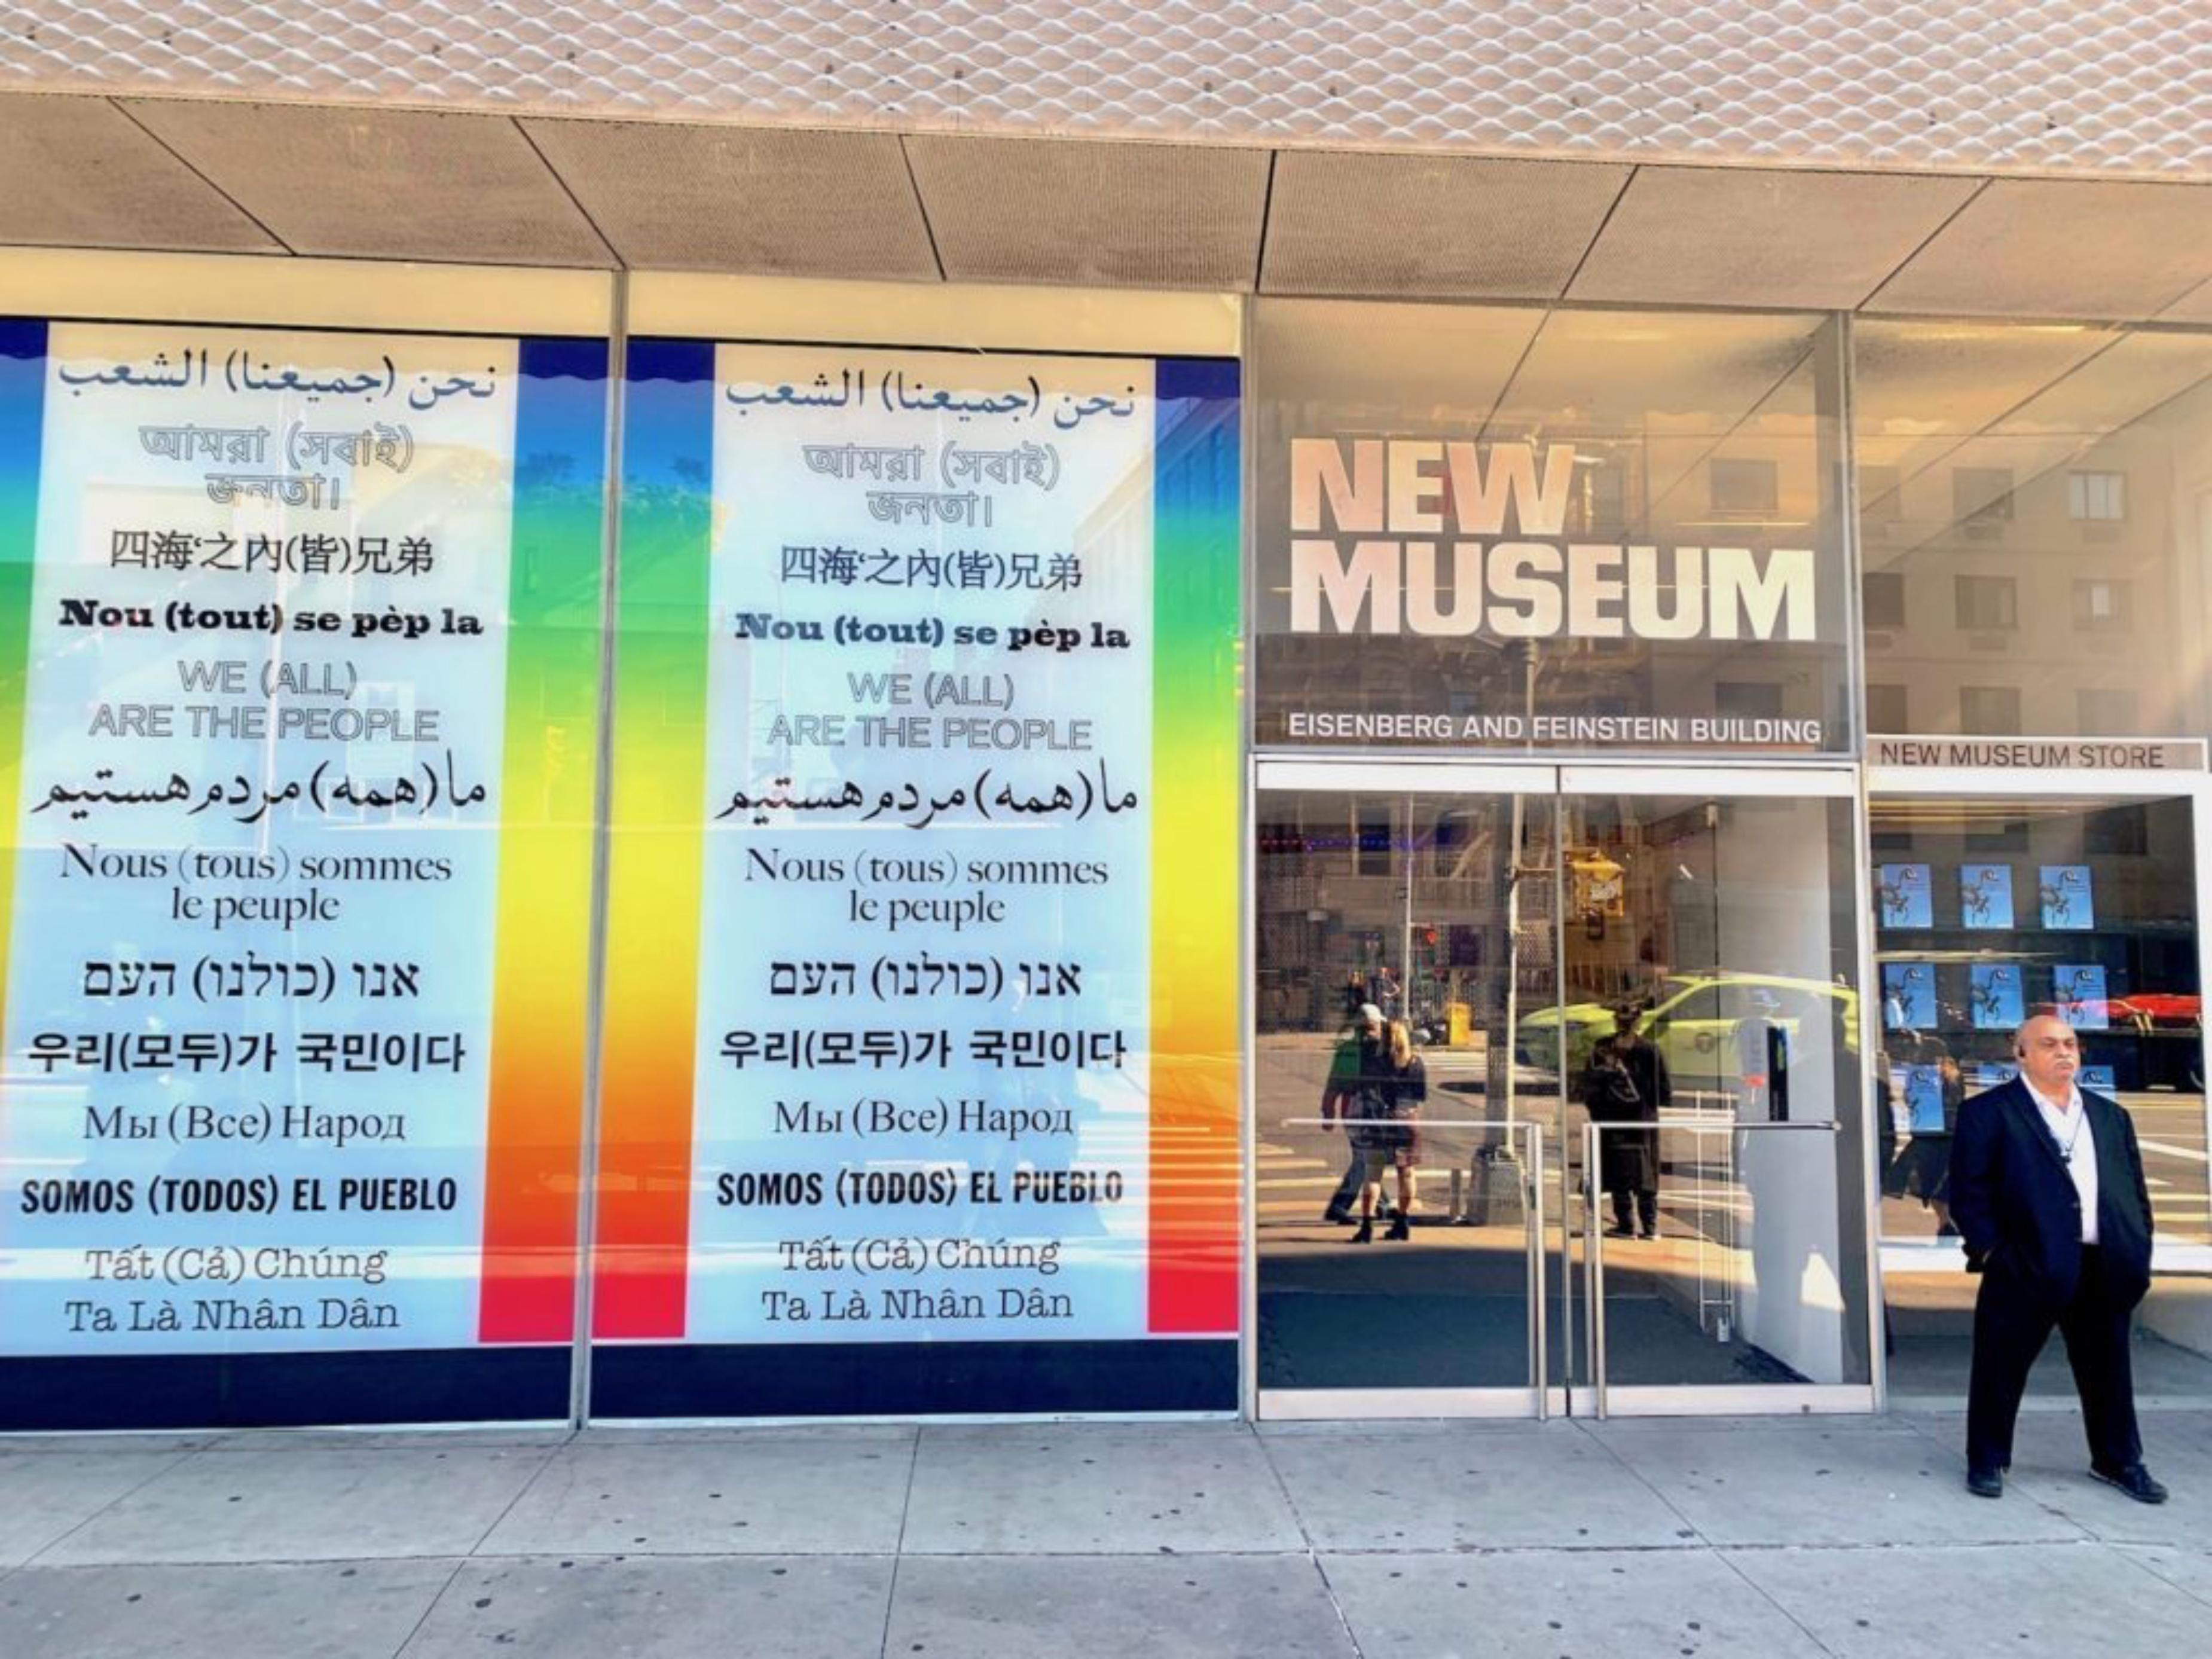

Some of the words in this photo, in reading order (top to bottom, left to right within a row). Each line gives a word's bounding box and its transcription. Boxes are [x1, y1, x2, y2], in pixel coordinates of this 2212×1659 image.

[59, 350, 207, 396] الشعب
[409, 365, 496, 410] نحن
[726, 368, 864, 416] الشعب
[1052, 385, 1135, 429] نحن
[139, 423, 270, 464] আমরা
[803, 442, 925, 482] আমরা
[1290, 438, 1576, 535] NEW
[1290, 540, 1816, 641] MUSEUM
[59, 598, 154, 627] Nou
[166, 602, 283, 635] (tout)
[294, 608, 341, 631] se
[350, 606, 431, 637] pèp
[441, 608, 482, 635] la
[735, 613, 824, 641] Nou
[835, 616, 944, 648] (tout)
[955, 621, 998, 644] se
[1008, 619, 1081, 652] pèp
[1090, 622, 1130, 648] la
[178, 660, 247, 693] WE
[261, 662, 358, 699] (ALL)
[847, 672, 912, 704] WE
[924, 674, 1015, 710] (ALL)
[88, 705, 173, 737] ARE
[185, 706, 265, 738] THE
[278, 708, 439, 741] PEOPLE
[768, 714, 845, 746] ARE
[861, 716, 931, 748] THE
[942, 718, 1093, 750] PEOPLE
[1288, 713, 1453, 738] EISENBERG
[1462, 716, 1524, 739] AND
[1532, 716, 1679, 741] FEINSTEIN
[1690, 719, 1822, 743] BUILDING
[1880, 743, 1941, 765] NEW
[1950, 744, 2070, 766] MUSEUM
[2079, 744, 2164, 768] STORE
[60, 844, 167, 879] Nous
[178, 846, 292, 884] (tous)
[300, 854, 451, 881] sommes
[745, 848, 844, 882] Nous
[855, 850, 957, 888] (tous)
[967, 859, 1109, 885] sommes
[172, 887, 202, 920] le
[215, 889, 340, 931] peuple
[850, 890, 878, 922] le
[890, 891, 1006, 931] peuple
[84, 961, 175, 997] העם
[352, 962, 420, 997] אנו
[771, 961, 856, 997] העם
[1019, 963, 1081, 995] אנו
[28, 1032, 277, 1073] 우리(모두)가
[297, 1032, 466, 1073] 국민이다
[720, 1029, 952, 1069] 우리(모두)가
[969, 1030, 1126, 1070] 국민이다
[83, 1106, 157, 1139] Мы
[169, 1102, 271, 1144] (Все)
[281, 1106, 405, 1147] Народ
[773, 1100, 841, 1134] Мы
[853, 1097, 949, 1138] (Все)
[958, 1101, 1073, 1141] Народ
[21, 1181, 135, 1215] SOMOS
[149, 1175, 279, 1215] (TODOS)
[292, 1180, 326, 1211] EL
[339, 1178, 457, 1211] PUEBLO
[717, 1173, 823, 1206] SOMOS
[837, 1168, 956, 1208] (TODOS)
[970, 1172, 1002, 1203] EL
[1014, 1171, 1123, 1203] PUEBLO
[255, 1248, 389, 1284] Chúng
[936, 1239, 1061, 1275] Chúng
[66, 1301, 116, 1332] Ta
[127, 1301, 181, 1332] Là
[193, 1301, 305, 1331] Nhân
[318, 1299, 399, 1328] Dân
[762, 1291, 810, 1321] Ta
[821, 1291, 871, 1320] Là
[882, 1291, 986, 1320] Nhân
[998, 1289, 1073, 1318] Dân
